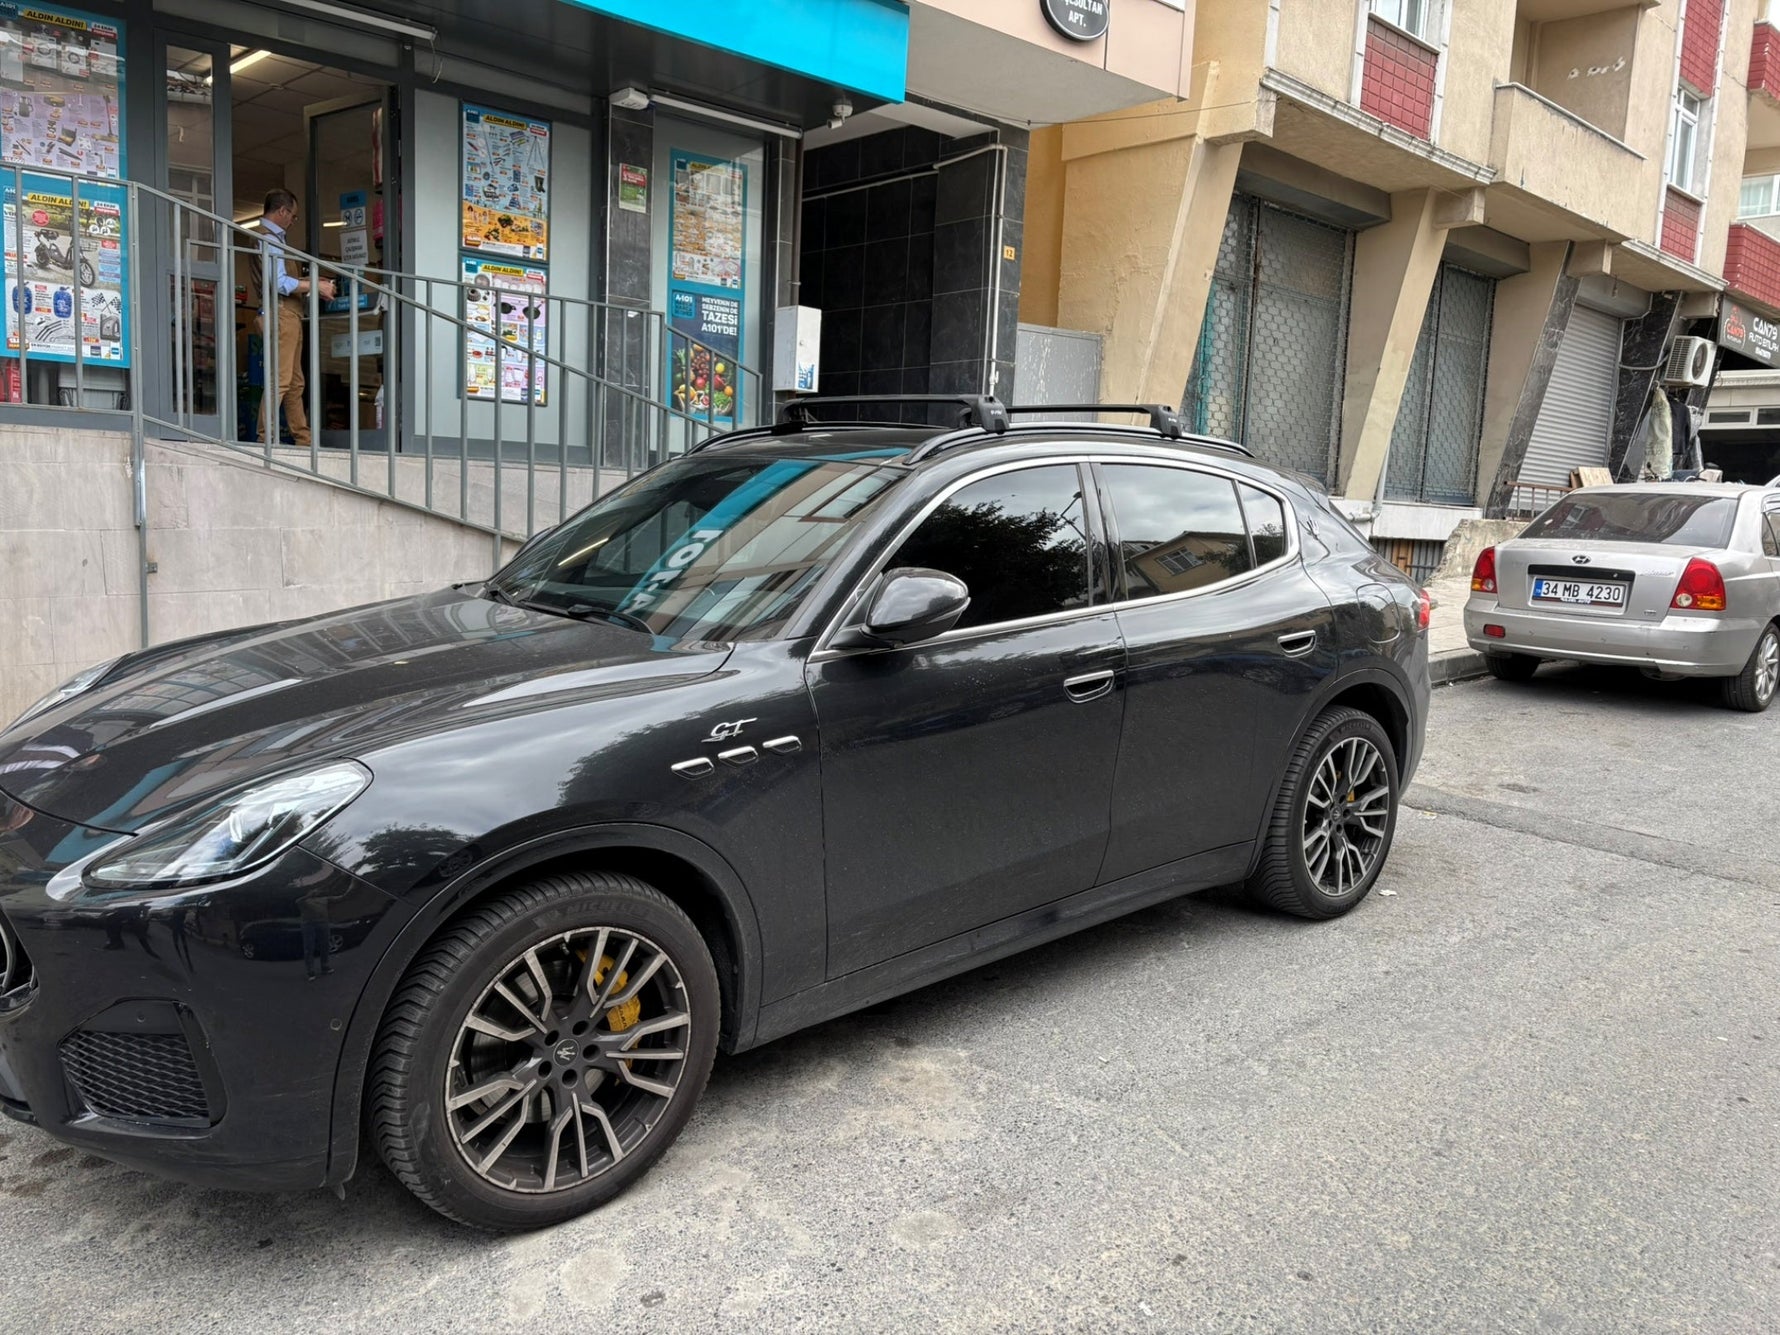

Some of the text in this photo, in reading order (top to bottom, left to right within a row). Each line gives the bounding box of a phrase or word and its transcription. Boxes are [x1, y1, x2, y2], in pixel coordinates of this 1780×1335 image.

[26, 10, 54, 22] ALDIN
[1068, 10, 1087, 27] APT.
[30, 193, 57, 204] ALDIN
[701, 310, 738, 325] TAZESİ
[1542, 582, 1558, 596] 34
[1562, 584, 1580, 598] MB
[1586, 585, 1621, 601] 4230
